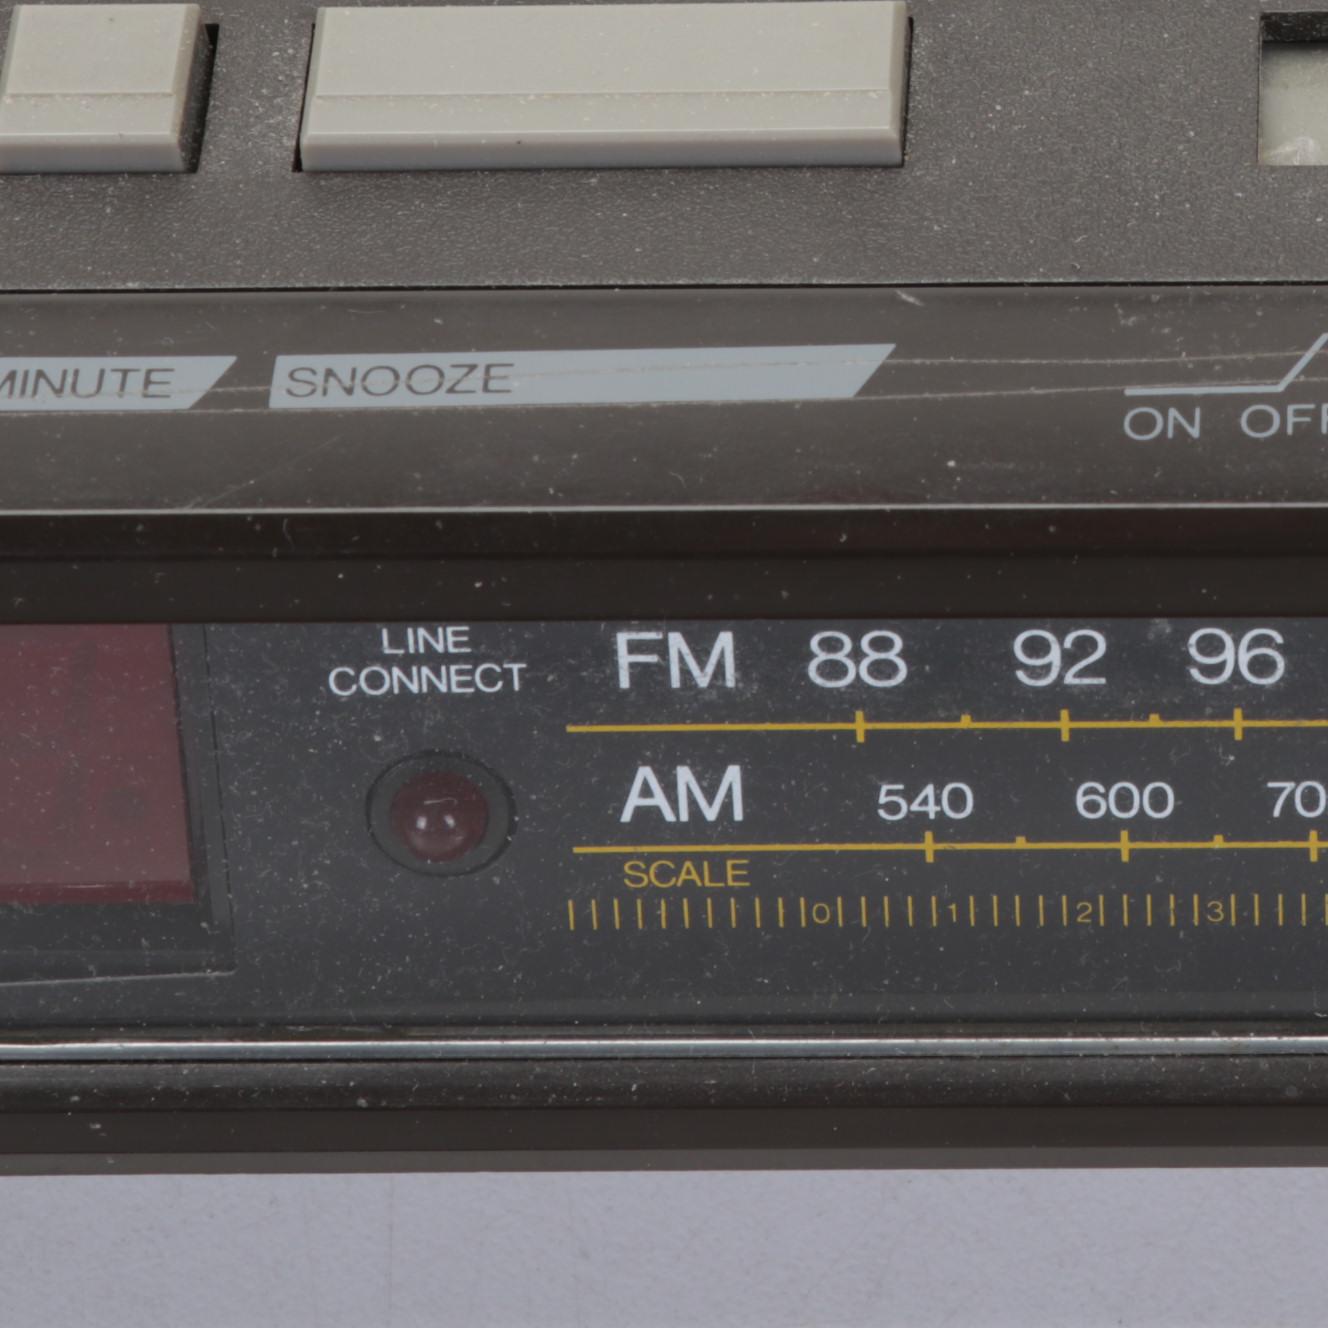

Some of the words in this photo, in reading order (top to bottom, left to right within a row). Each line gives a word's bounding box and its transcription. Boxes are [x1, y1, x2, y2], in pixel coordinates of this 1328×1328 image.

[285, 363, 514, 398] SNOOZE
[1123, 406, 1201, 441] ON
[381, 626, 472, 655] LINE
[616, 631, 736, 689] FM
[807, 630, 908, 688] 88
[1013, 629, 1107, 687] 92
[1187, 627, 1285, 686] 96
[328, 663, 527, 697] CONNECT
[620, 764, 744, 823] AM
[877, 782, 974, 821] 540
[1075, 781, 1175, 820] 600
[623, 858, 749, 889] SCALE
[812, 902, 832, 924] 0
[1076, 901, 1094, 924] 2
[1207, 900, 1225, 922] 3
